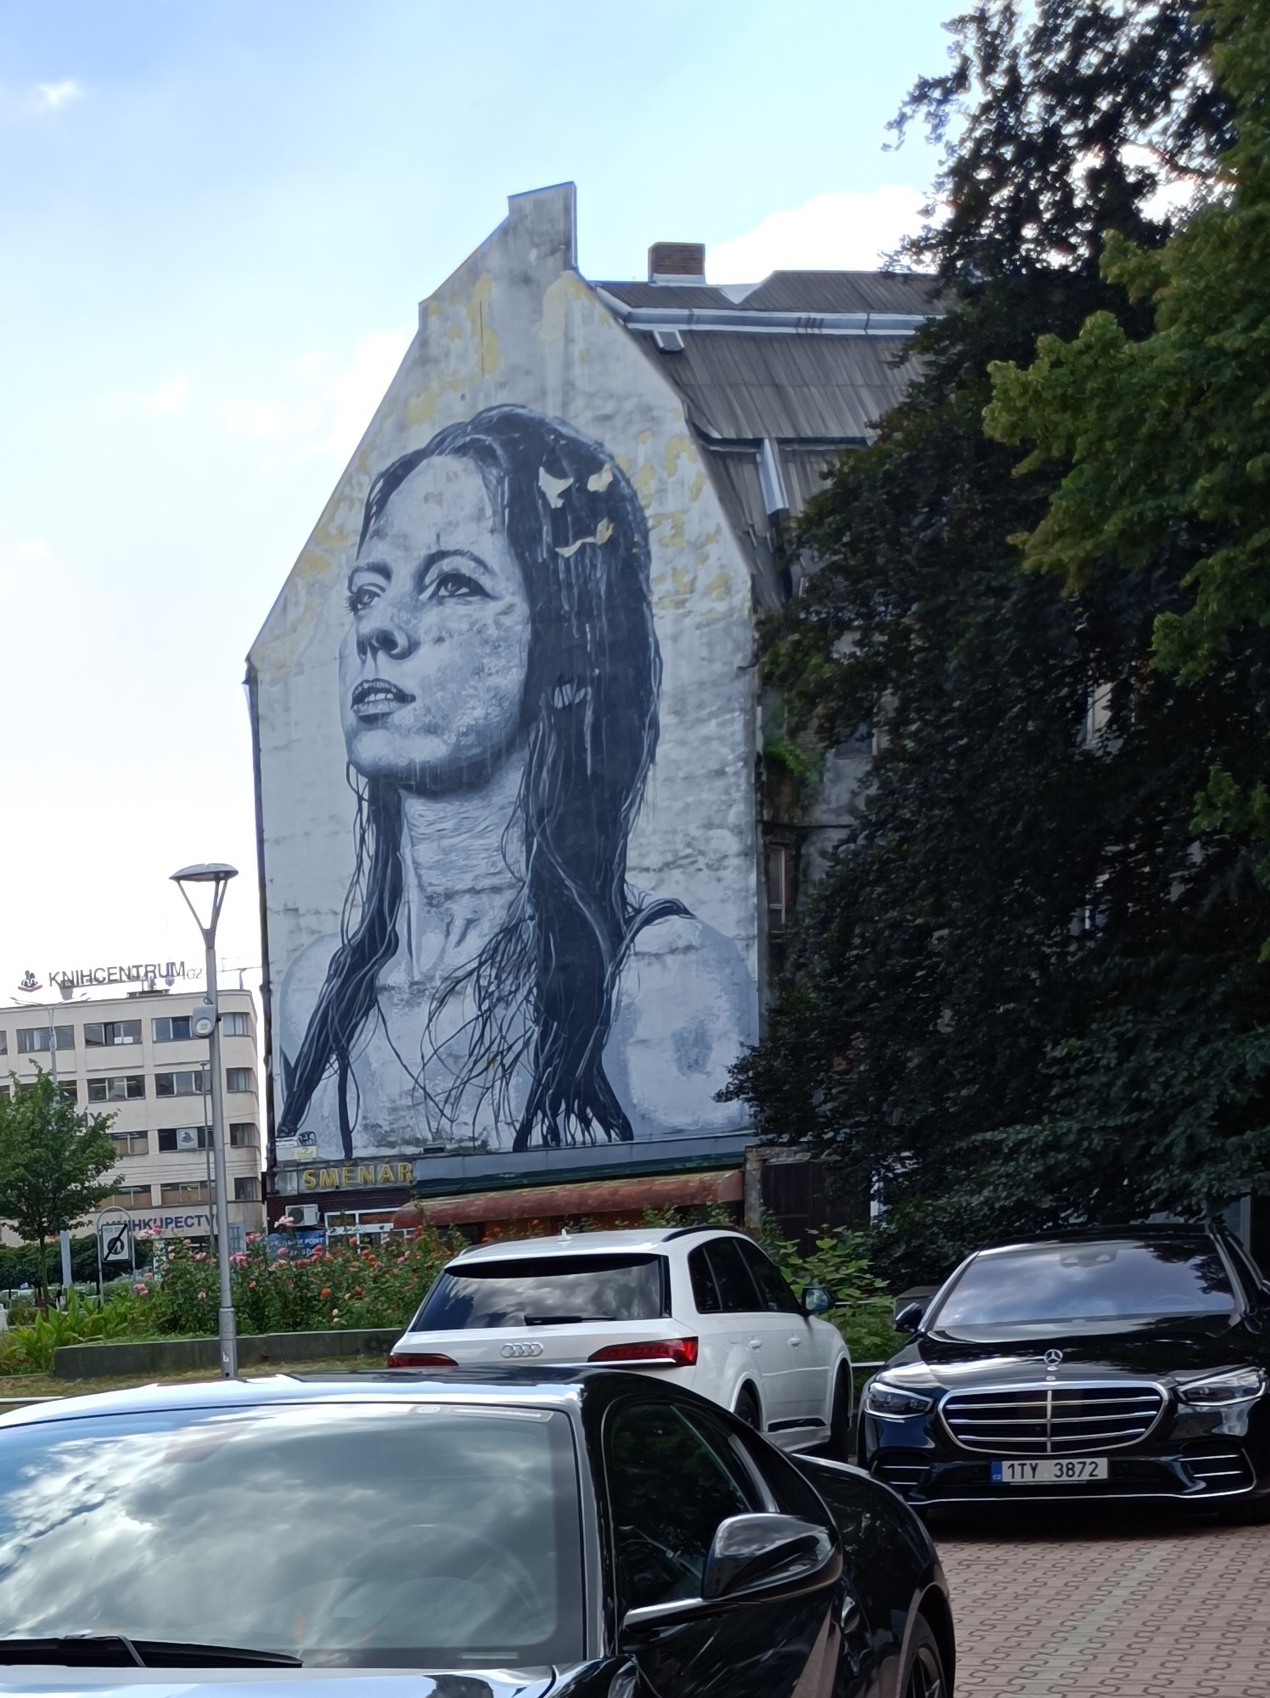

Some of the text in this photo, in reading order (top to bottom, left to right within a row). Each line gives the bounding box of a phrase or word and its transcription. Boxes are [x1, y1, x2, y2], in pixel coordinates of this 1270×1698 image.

[49, 961, 185, 987] KNIHCENTRUM
[1007, 1461, 1099, 1479] 1TY 3872
